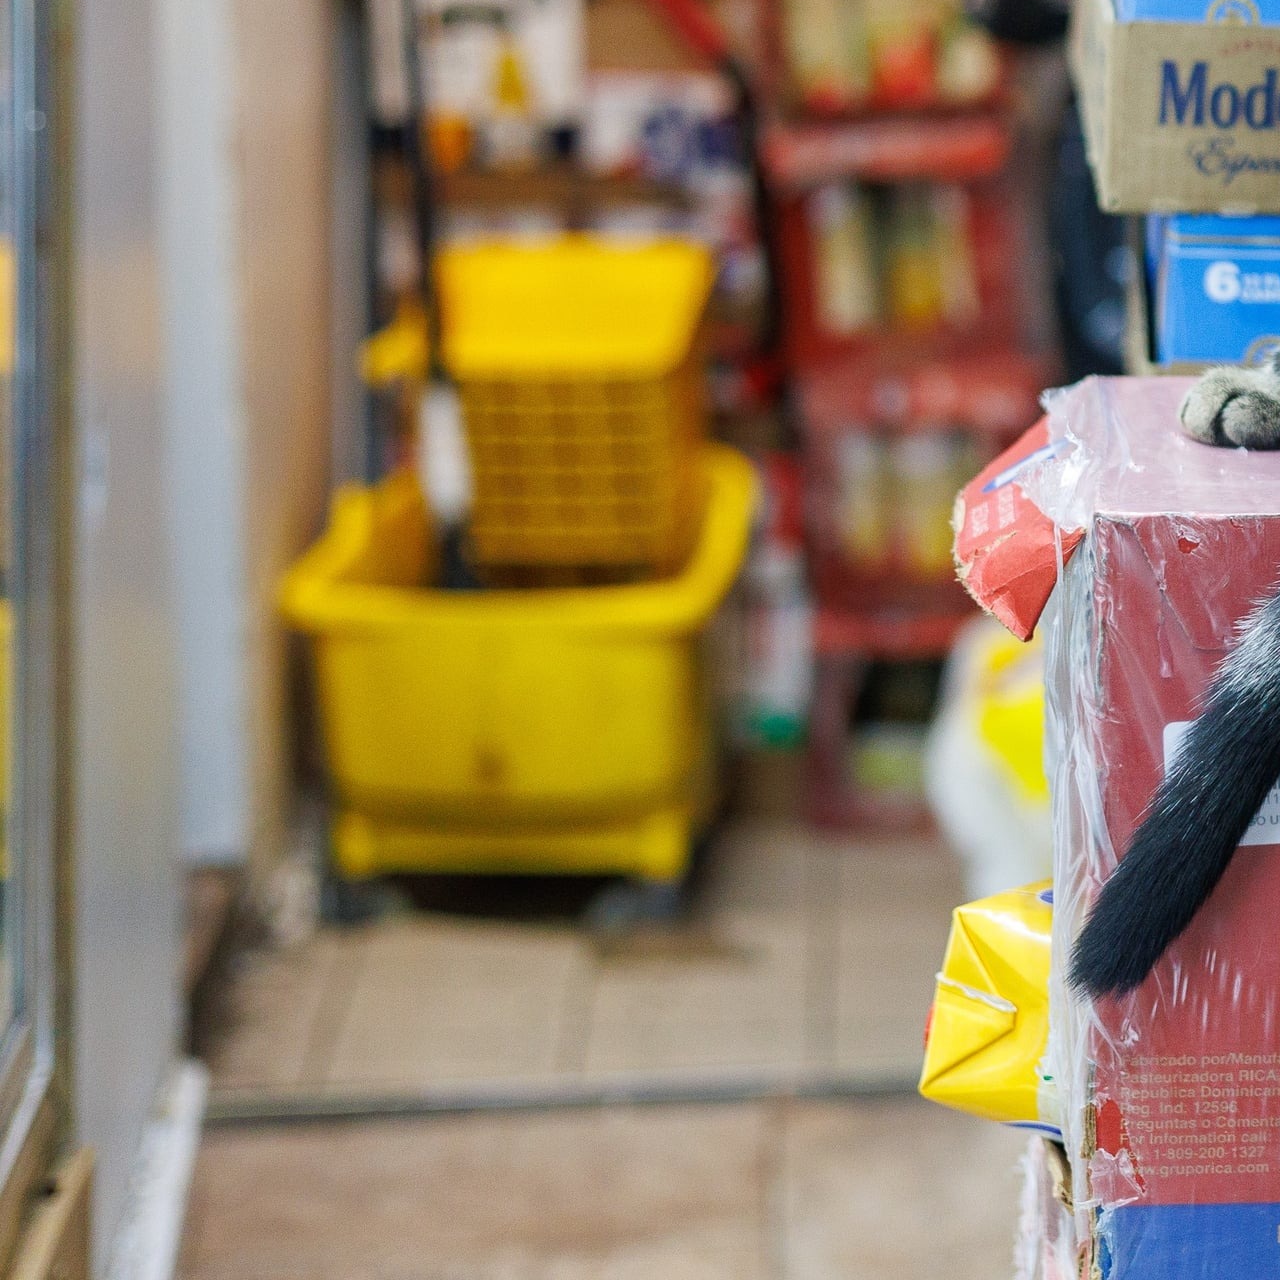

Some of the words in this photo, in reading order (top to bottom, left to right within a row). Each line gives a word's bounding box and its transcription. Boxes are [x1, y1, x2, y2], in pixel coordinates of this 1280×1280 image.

[1204, 261, 1240, 304] 6
[1120, 1070, 1234, 1084] Pasteurizadora
[1150, 1130, 1236, 1145] Information
